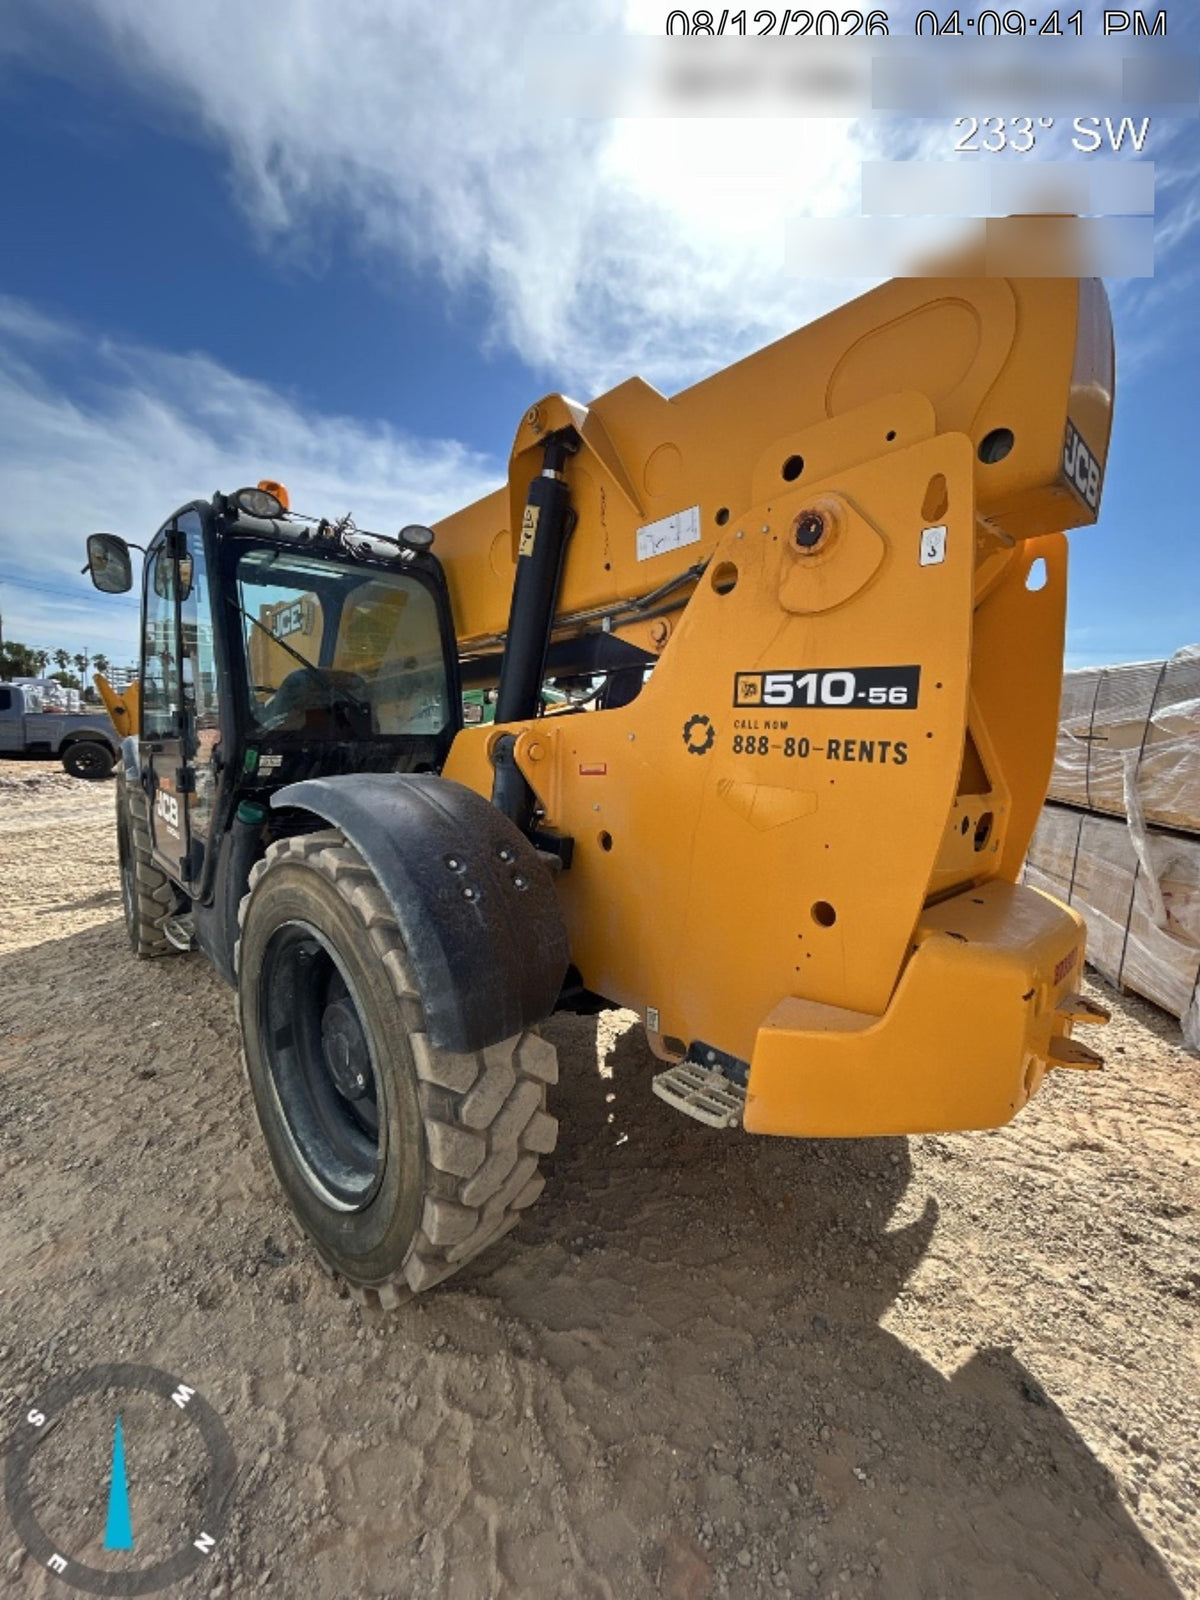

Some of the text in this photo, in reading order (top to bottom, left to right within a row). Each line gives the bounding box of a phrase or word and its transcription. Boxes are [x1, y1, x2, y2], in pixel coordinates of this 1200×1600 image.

[1064, 431, 1100, 507] JCB
[734, 719, 788, 731] CALL NOW
[732, 735, 908, 765] 888-80-RENTS
[156, 790, 178, 828] JCB
